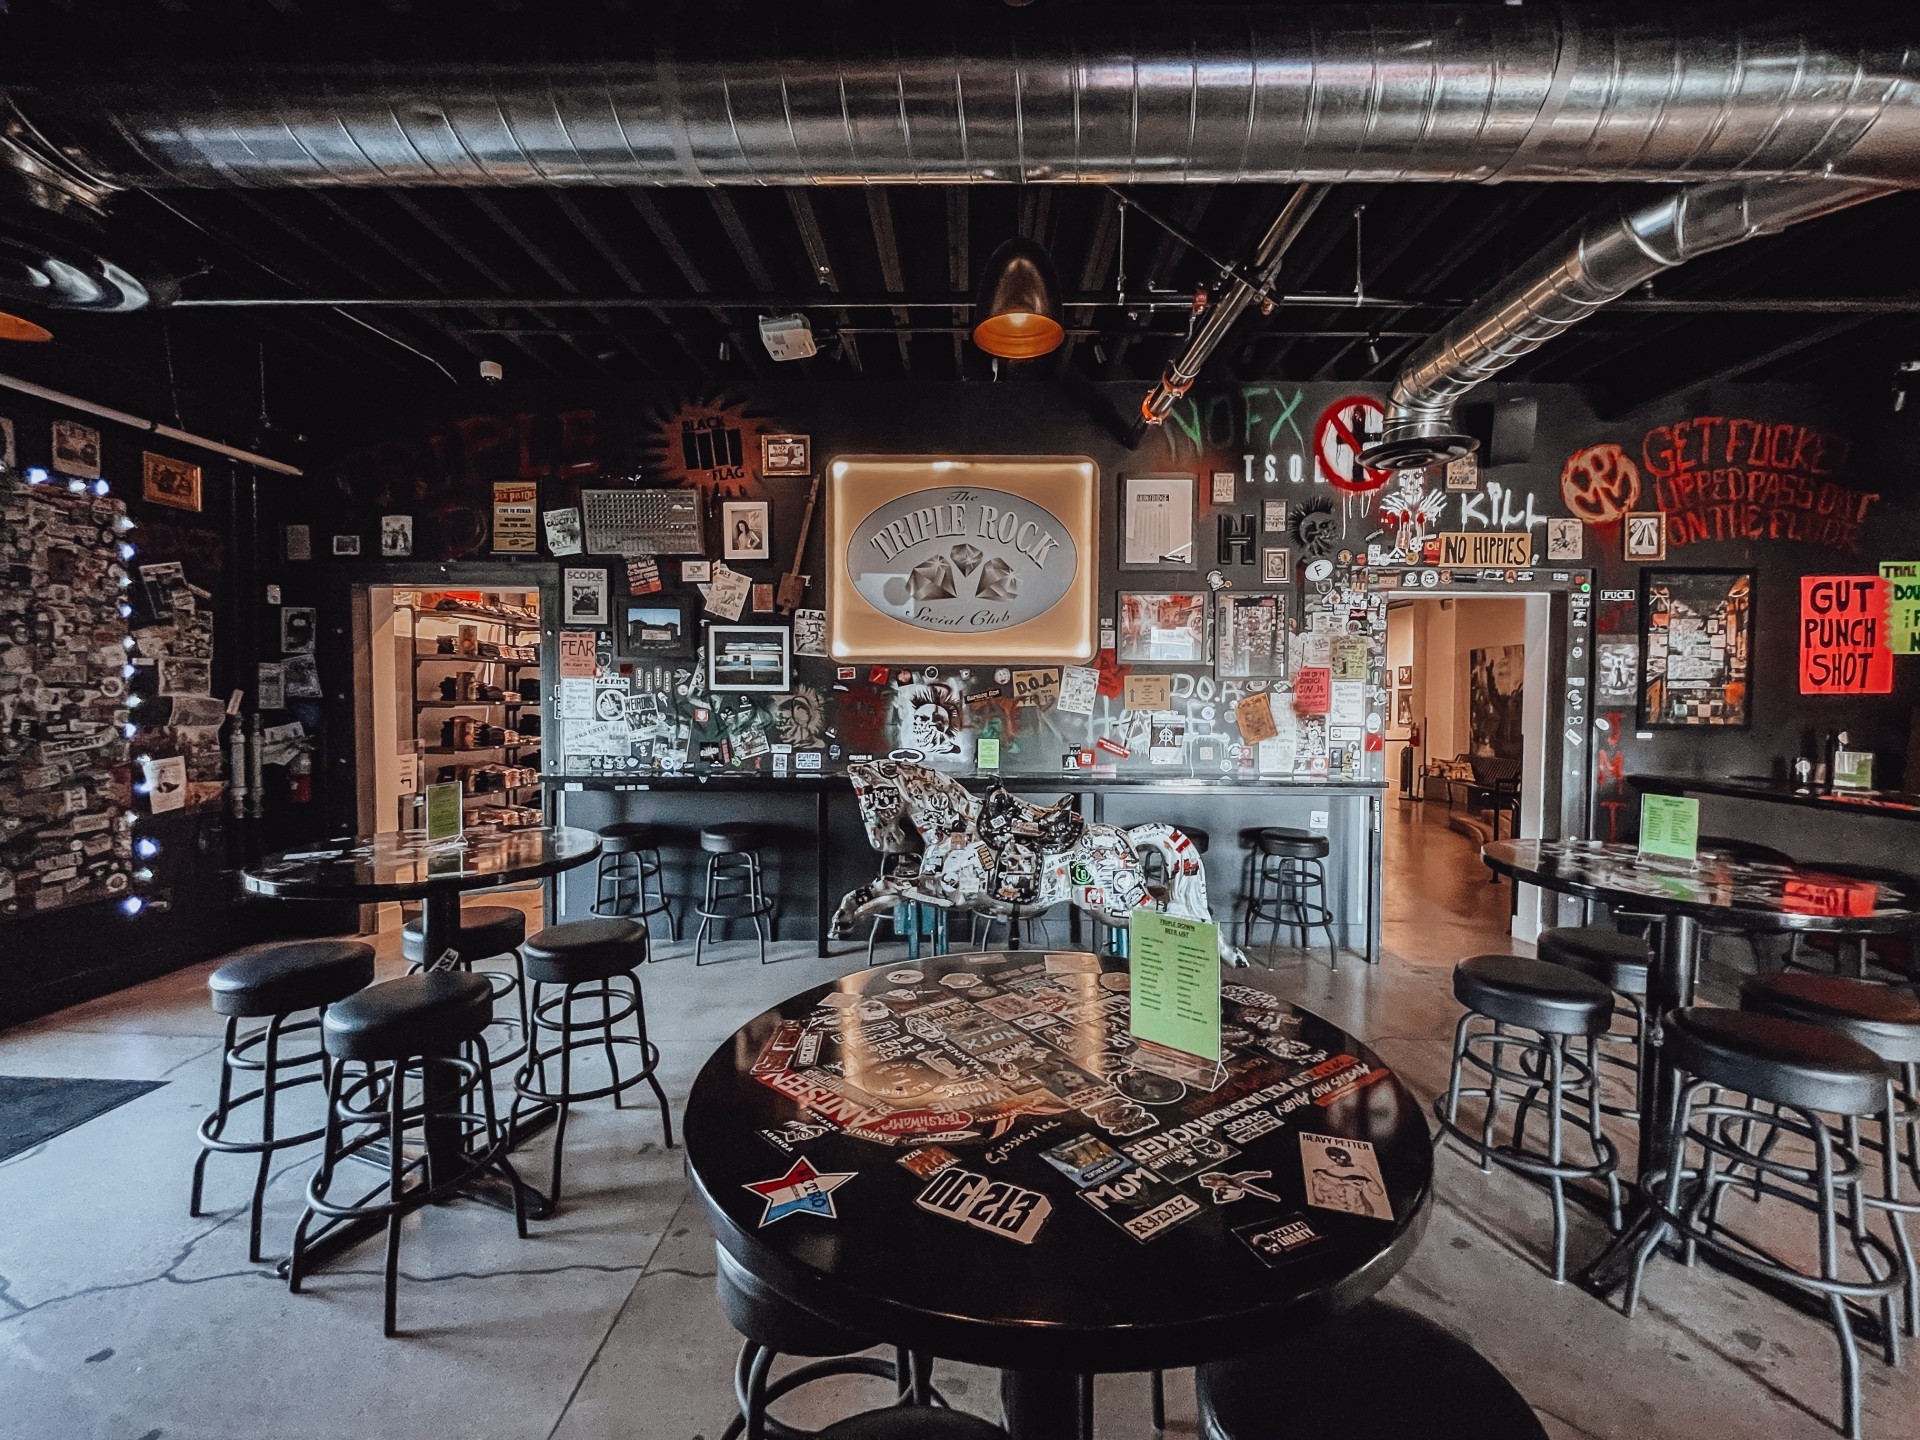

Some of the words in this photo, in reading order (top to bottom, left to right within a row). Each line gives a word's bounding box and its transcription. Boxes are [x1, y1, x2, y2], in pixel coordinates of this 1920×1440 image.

[682, 416, 727, 431] BLACK
[1642, 416, 1724, 476] GET
[1725, 419, 1848, 474] FUCKE
[711, 466, 744, 481] FLAG
[947, 491, 978, 502] The
[1748, 471, 1815, 509] PASS
[1461, 482, 1548, 533] KILL
[870, 503, 967, 564] TRIPLE
[977, 504, 1060, 570] ROCK
[1666, 511, 1710, 548] ON
[1444, 536, 1467, 564] NO
[1473, 536, 1526, 565] HIPPIES
[1604, 591, 1631, 600] FUCK
[1810, 580, 1875, 614] GUT
[905, 606, 965, 626] Social
[969, 610, 1011, 626] Club
[1805, 618, 1876, 648] PUNCH
[561, 640, 595, 656] FEAR
[1809, 652, 1873, 688] SHOT
[1015, 672, 1059, 695] D.O.A.
[961, 1027, 1022, 1050] NOFX
[937, 1040, 1001, 1082] PENNYWIS
[806, 1109, 840, 1131] ARCANE
[1223, 1110, 1271, 1133] CHAOS
[761, 1129, 794, 1152] AGENDA
[1131, 1116, 1213, 1160] KICKER
[1302, 1133, 1332, 1145] HEAVY
[1334, 1137, 1370, 1151] PETTER
[897, 1149, 924, 1164] PIZZA
[1130, 1197, 1194, 1235] RIDAZ
